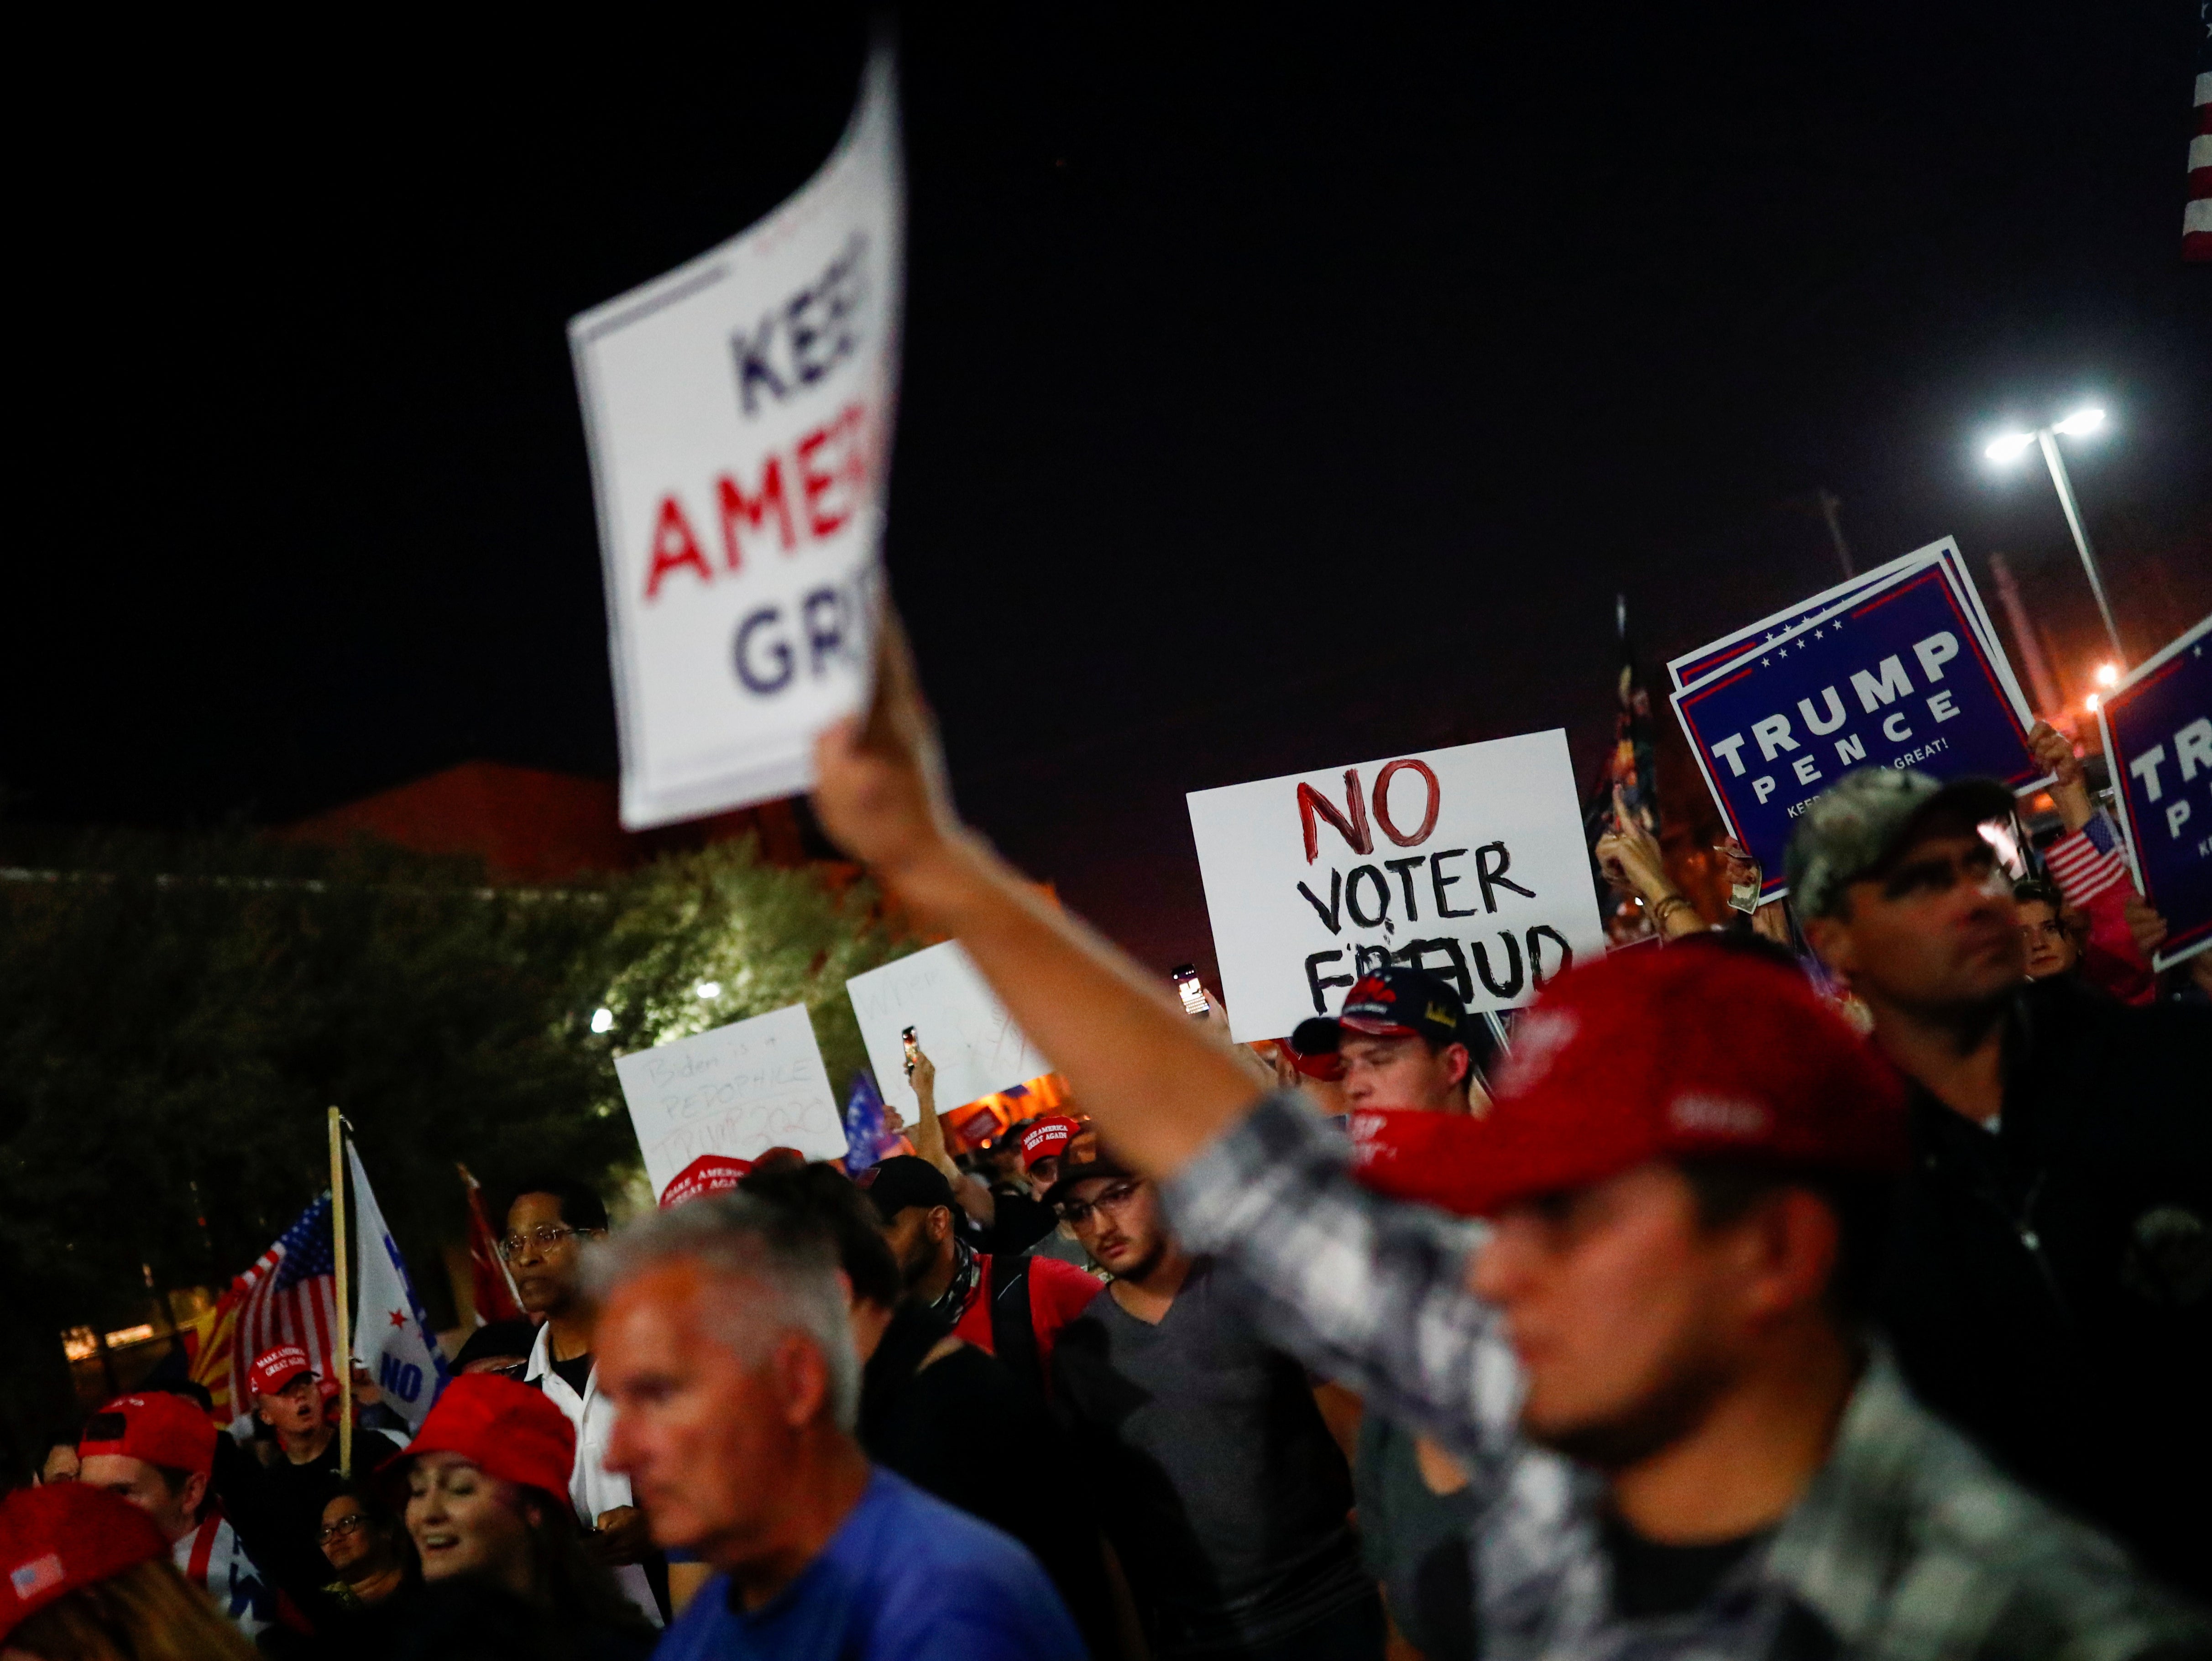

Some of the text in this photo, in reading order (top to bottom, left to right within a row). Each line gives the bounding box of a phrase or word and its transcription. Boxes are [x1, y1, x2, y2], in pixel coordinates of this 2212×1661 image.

[732, 576, 865, 695] GR
[1710, 630, 1960, 778] TRUMP
[1752, 689, 1961, 805] PENCE
[1894, 736, 1958, 770] GREAT!
[1297, 758, 1440, 865] NO
[1296, 841, 1536, 935] VOTER
[660, 1058, 814, 1120] PEDOPHILE
[1023, 1124, 1068, 1146] MAKE AMERICA
[1027, 1132, 1067, 1151] GREAT AGAIN
[379, 1352, 423, 1404] NO
